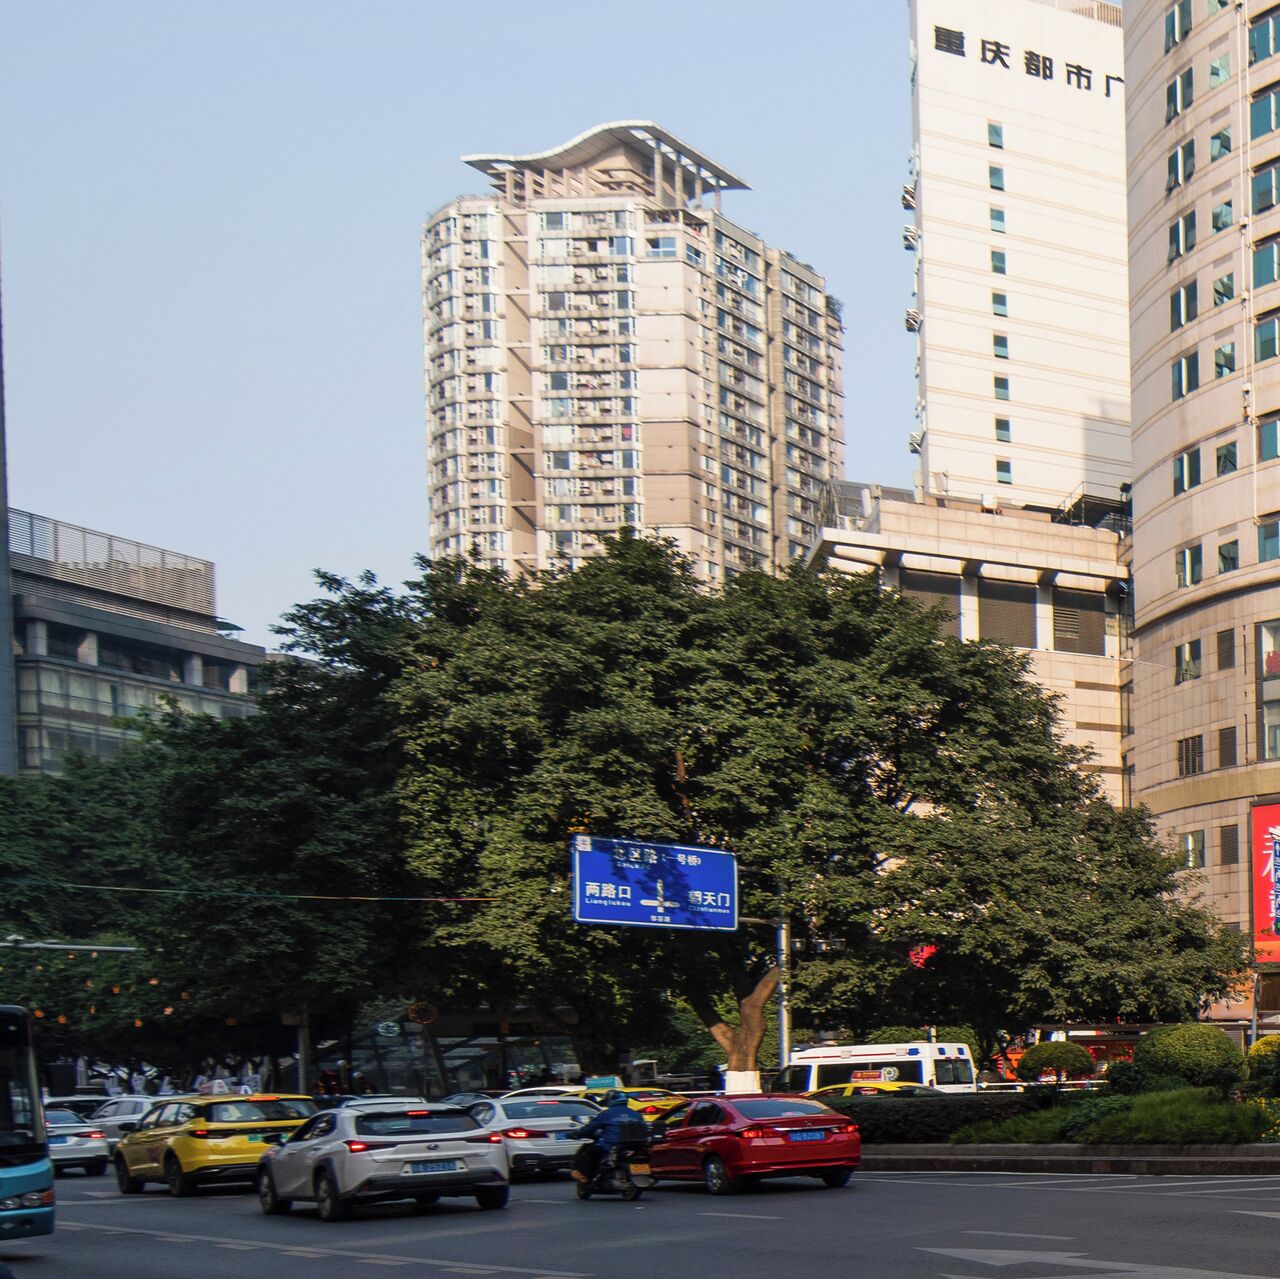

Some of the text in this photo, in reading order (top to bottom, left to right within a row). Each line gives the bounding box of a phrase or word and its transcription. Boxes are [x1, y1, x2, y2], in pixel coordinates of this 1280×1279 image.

[585, 881, 632, 899] 两路口
[688, 890, 731, 907] 朝天门
